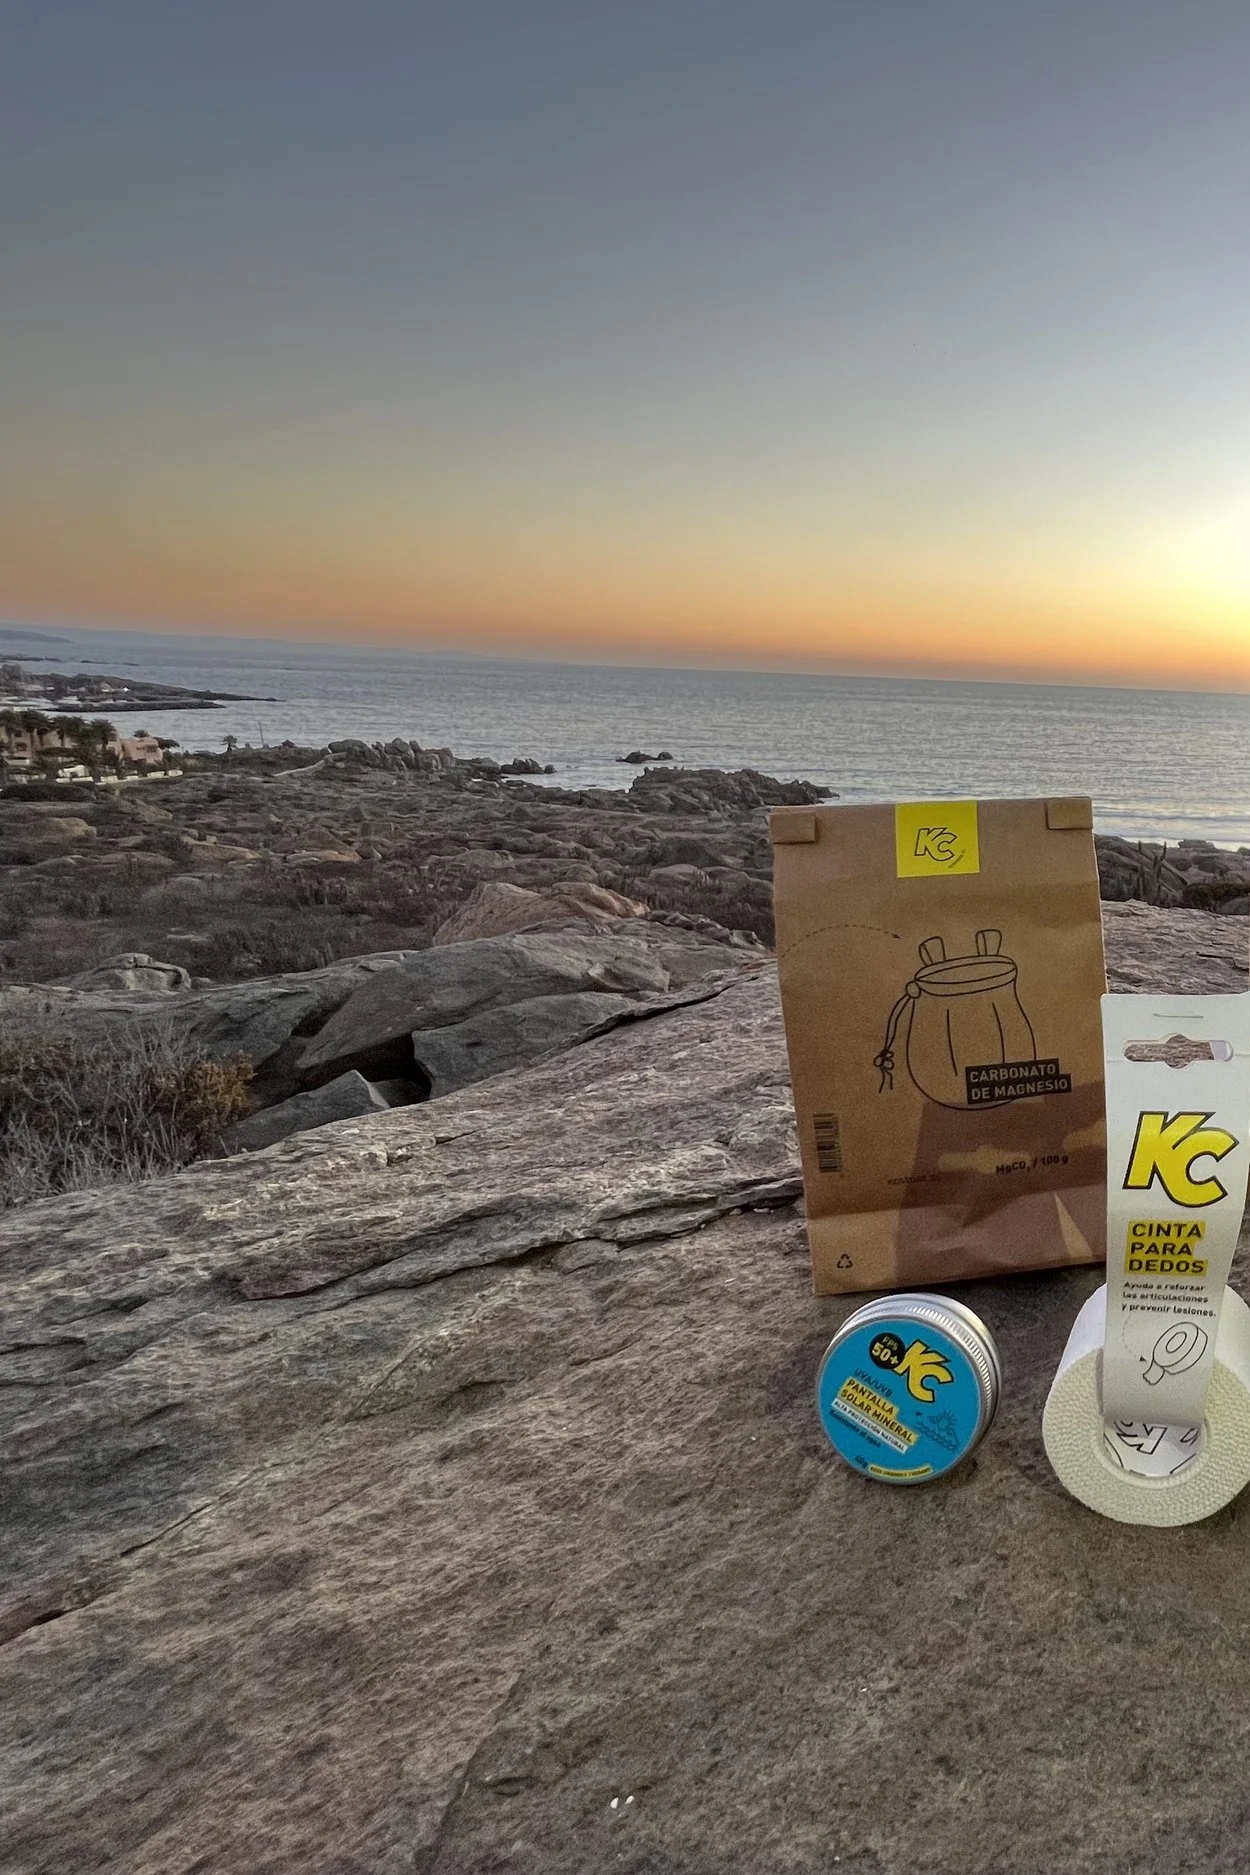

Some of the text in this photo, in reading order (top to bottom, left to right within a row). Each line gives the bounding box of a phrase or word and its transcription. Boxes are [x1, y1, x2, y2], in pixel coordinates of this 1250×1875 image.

[914, 827, 958, 862] KC
[969, 1063, 1056, 1083] CARBONATO
[971, 1078, 1068, 1100] DE MAGNESIO
[1041, 1155, 1059, 1165] 100
[1122, 1110, 1240, 1208] KC
[1131, 1223, 1203, 1238] CINTA
[1130, 1241, 1193, 1256] PARA
[1128, 1259, 1204, 1273] DEDOS
[1124, 1281, 1154, 1290] Ayuda
[1164, 1283, 1205, 1291] reforzar
[1123, 1291, 1208, 1303] las articulaciones
[1121, 1303, 1217, 1317] y prevenir lesiones.
[871, 1342, 899, 1365] 50+
[882, 1336, 898, 1351] FPS
[891, 1338, 955, 1403] KC
[847, 1379, 894, 1415] PANTALLA
[834, 1401, 847, 1413] ALTA
[847, 1408, 881, 1434] PROTECCIÓN
[881, 1430, 905, 1451] NATURAL
[841, 1389, 872, 1414] SOLAR
[872, 1409, 913, 1443] MINERAL
